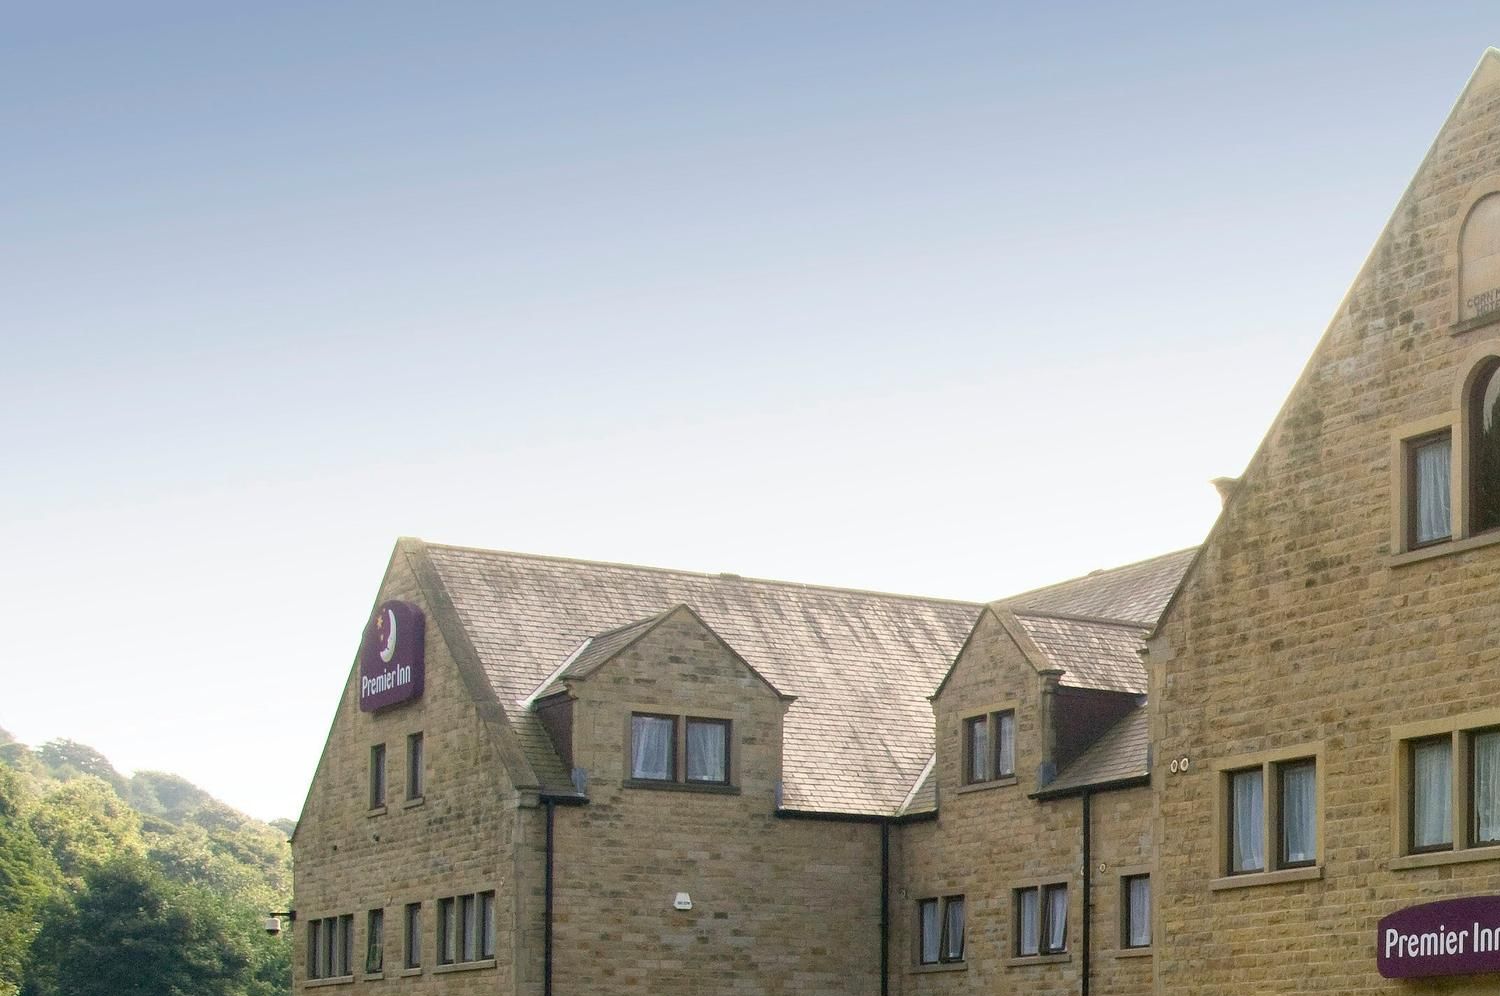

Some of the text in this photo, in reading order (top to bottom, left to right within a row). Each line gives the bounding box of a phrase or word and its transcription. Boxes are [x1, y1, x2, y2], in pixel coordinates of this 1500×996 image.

[1466, 290, 1494, 308] CORN
[362, 663, 411, 698] Premier Inn
[1385, 924, 1469, 959] Premier
